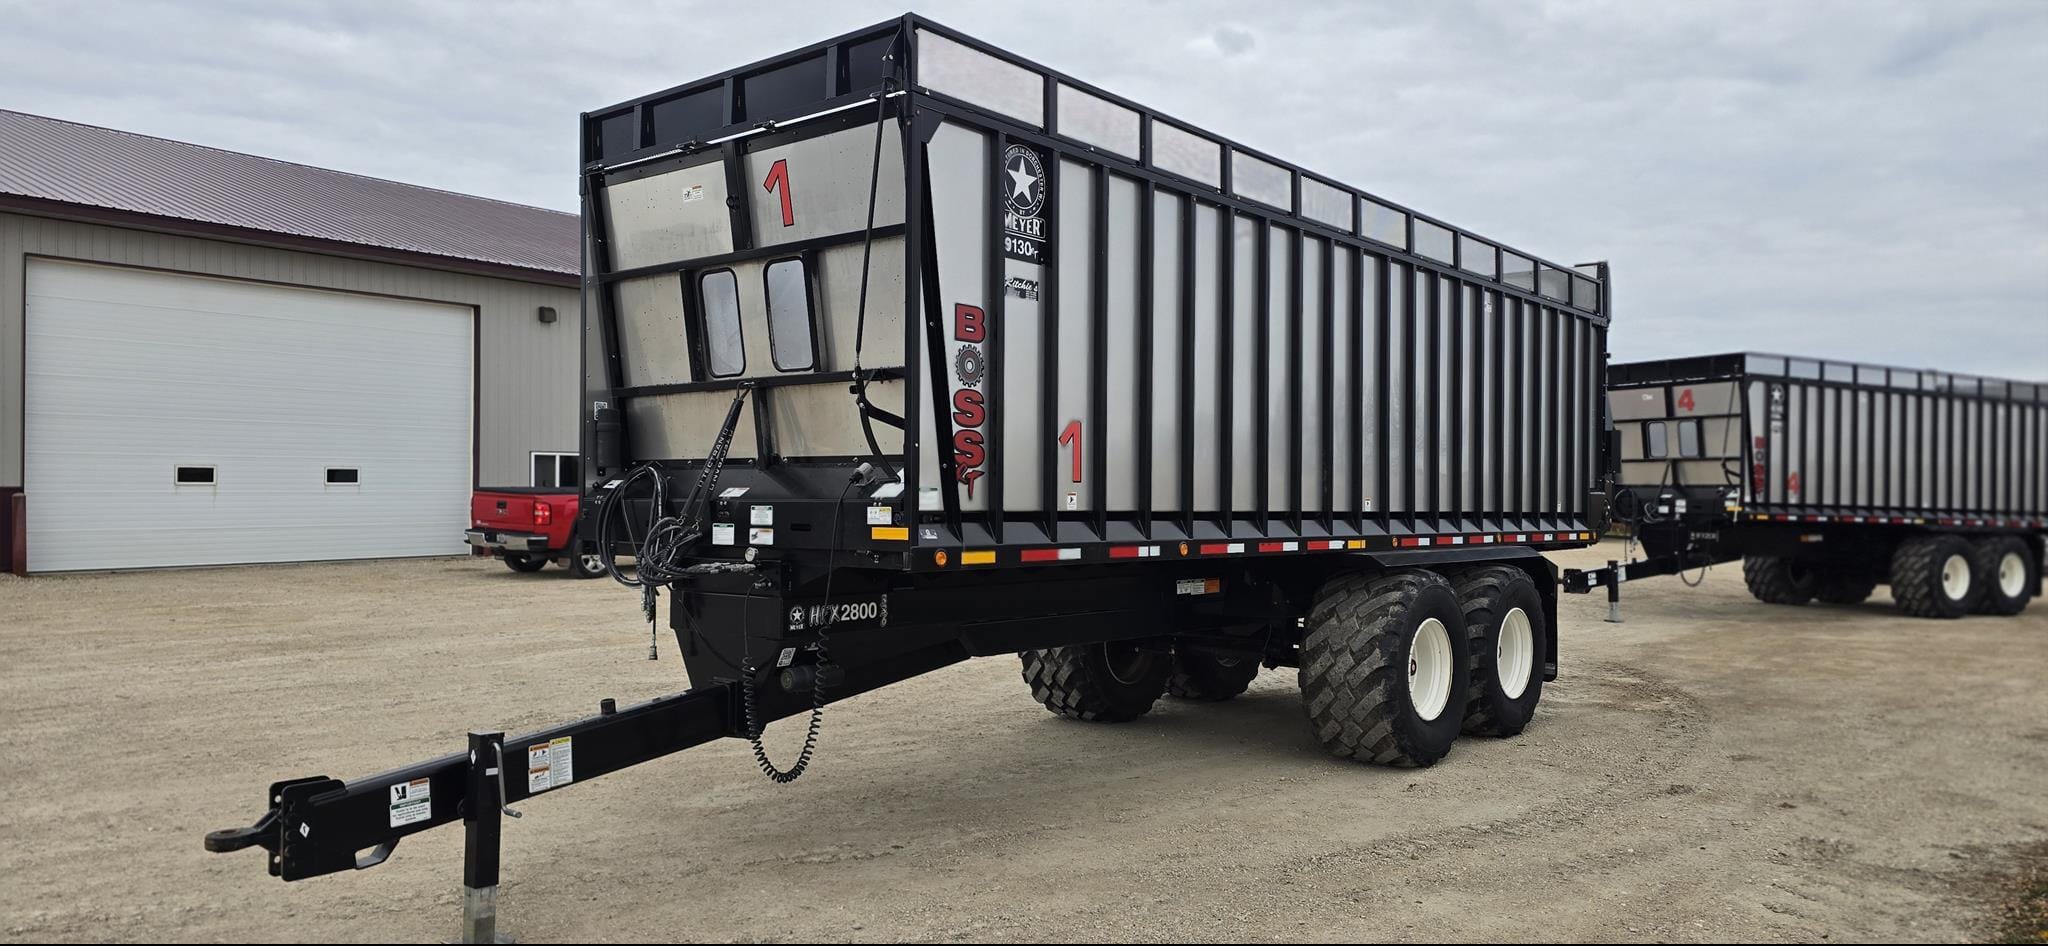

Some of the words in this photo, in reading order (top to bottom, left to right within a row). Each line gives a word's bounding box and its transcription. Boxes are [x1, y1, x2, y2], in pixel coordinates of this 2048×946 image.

[763, 158, 795, 228] 1
[1004, 212, 1041, 236] MEYER
[1678, 388, 1695, 411] 4
[1058, 419, 1082, 483] 1
